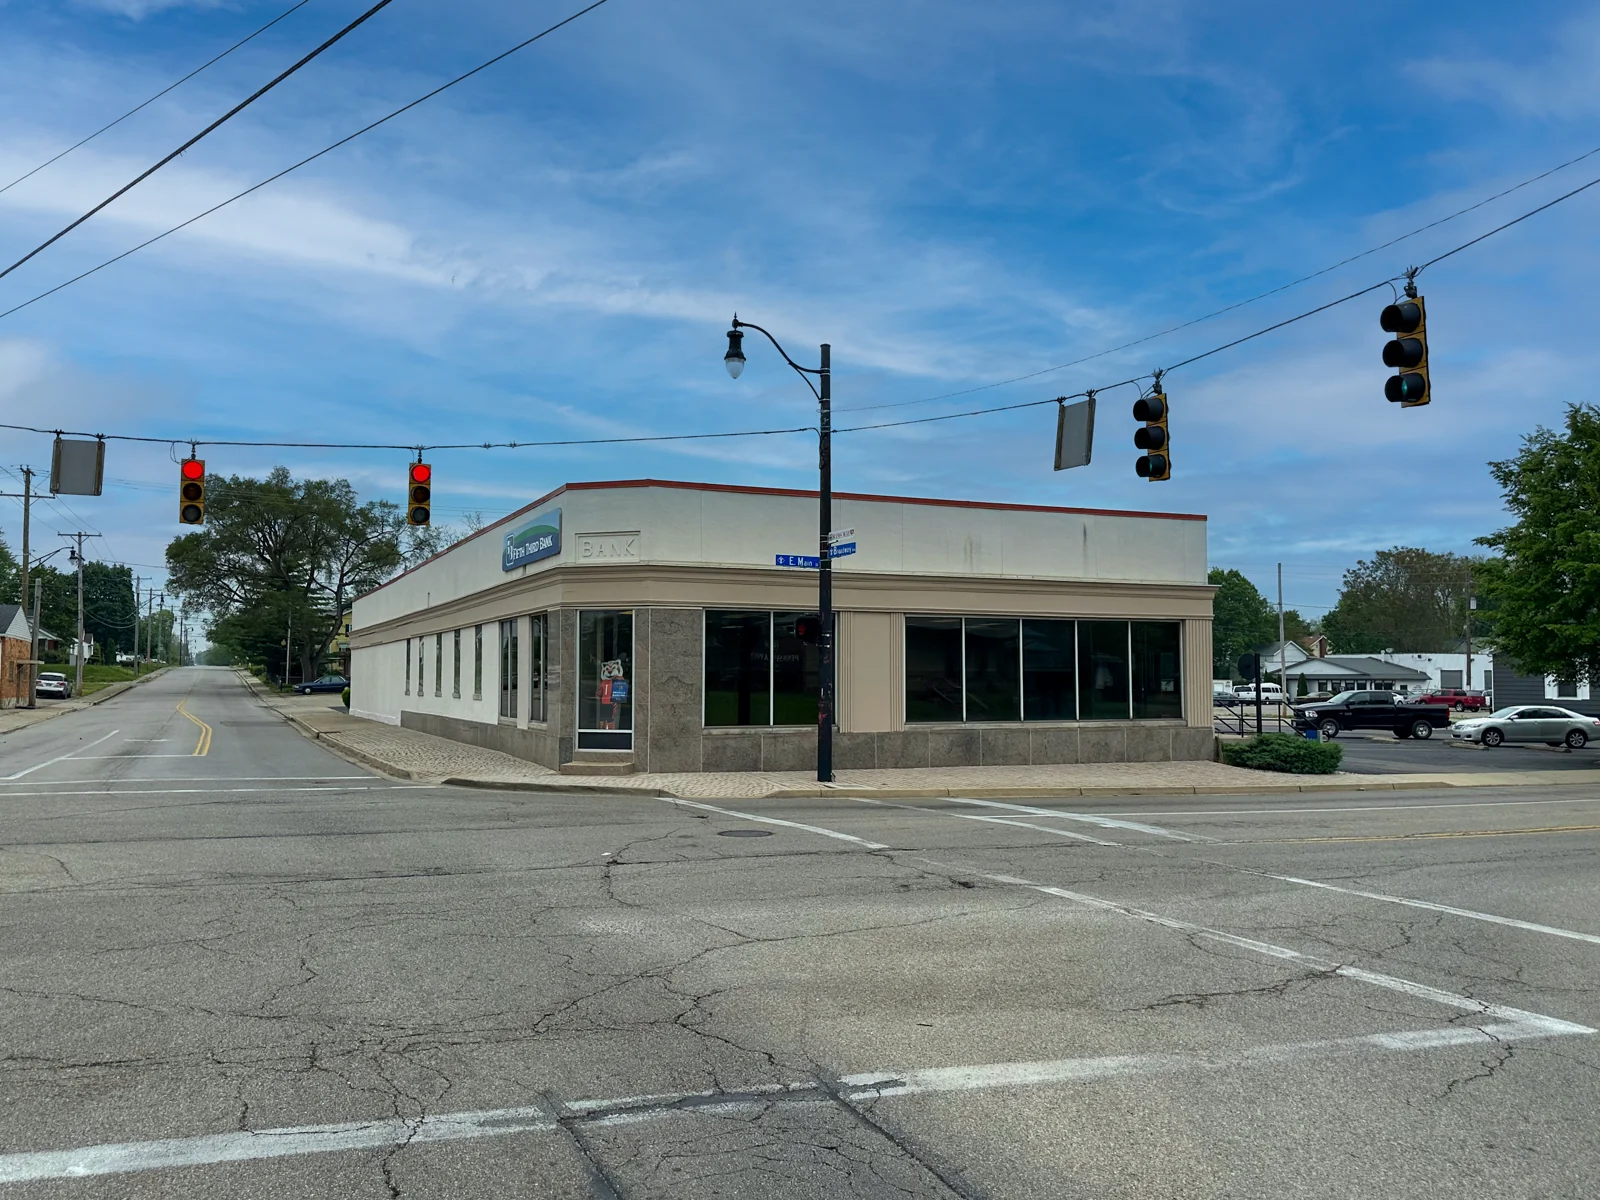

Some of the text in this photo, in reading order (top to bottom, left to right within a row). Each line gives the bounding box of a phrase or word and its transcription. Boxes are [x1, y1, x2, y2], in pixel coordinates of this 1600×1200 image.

[513, 546, 525, 560] FIFTH
[525, 541, 539, 556] THIRD
[539, 535, 553, 551] BANK
[582, 539, 635, 558] BANK
[797, 557, 813, 567] Main
